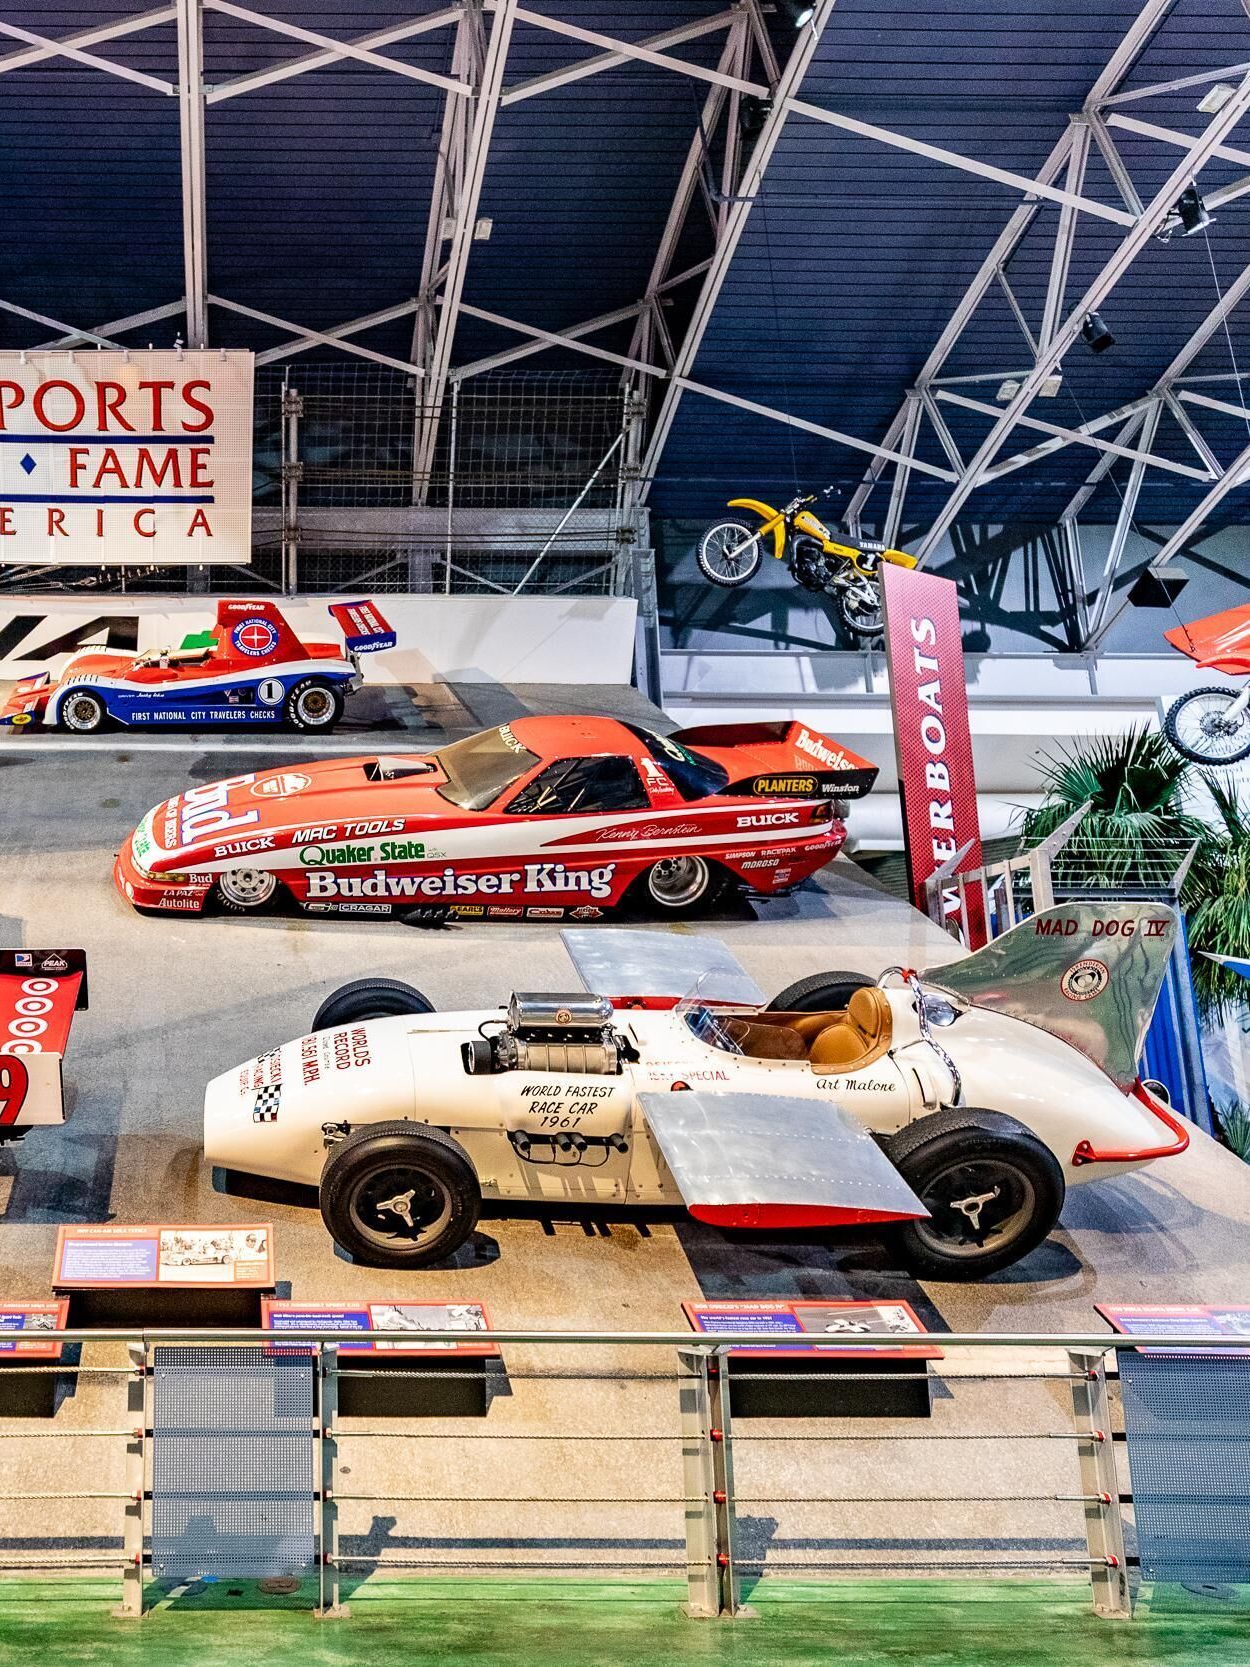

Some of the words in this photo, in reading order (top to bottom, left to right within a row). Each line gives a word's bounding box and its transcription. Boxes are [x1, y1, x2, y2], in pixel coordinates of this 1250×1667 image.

[69, 447, 215, 489] FAME
[860, 541, 887, 551] YAMAHA
[862, 554, 875, 571] 1
[228, 603, 265, 611] GOODYEAR
[354, 641, 393, 652] GOODYEAR
[266, 681, 275, 699] 1
[131, 712, 150, 721] FIRST
[154, 711, 187, 720] NATIONAL
[190, 711, 206, 720] CITY
[209, 711, 246, 720] TRAVELERS
[250, 710, 275, 719] CHECKS
[499, 725, 527, 754] BUICK
[641, 758, 664, 778] 1
[757, 777, 814, 792] PLANTERS
[822, 783, 860, 794] Winston
[737, 813, 799, 828] BUICK
[292, 825, 338, 844] MAC
[344, 818, 406, 837] TOOLS
[596, 827, 639, 843] Kenny
[641, 824, 703, 838] Bernstein
[214, 835, 276, 857] BUICK
[299, 845, 375, 866] Quaker
[379, 841, 426, 861] State
[725, 851, 756, 860] SIMPSON
[761, 847, 797, 856] RACEPAK
[741, 859, 780, 869] MOROSO
[189, 874, 213, 884] Bud
[305, 868, 521, 897] Budweiser
[524, 863, 617, 898] King
[159, 897, 200, 910] Autolite
[340, 904, 390, 913] CRAGAR
[1035, 918, 1079, 937] MAD
[1091, 919, 1135, 937] DOG
[1143, 919, 1170, 937] IV
[333, 1031, 351, 1071] RECORD
[351, 1026, 371, 1067] WORLD'S
[680, 1070, 731, 1081] SPECIAL
[521, 1085, 562, 1097] WORLD
[565, 1086, 616, 1097] FASTEST
[816, 1078, 841, 1091] Art
[845, 1078, 897, 1092] Malone
[529, 1101, 565, 1114] RACE
[569, 1102, 598, 1114] CAR
[540, 1115, 582, 1128] 1961
